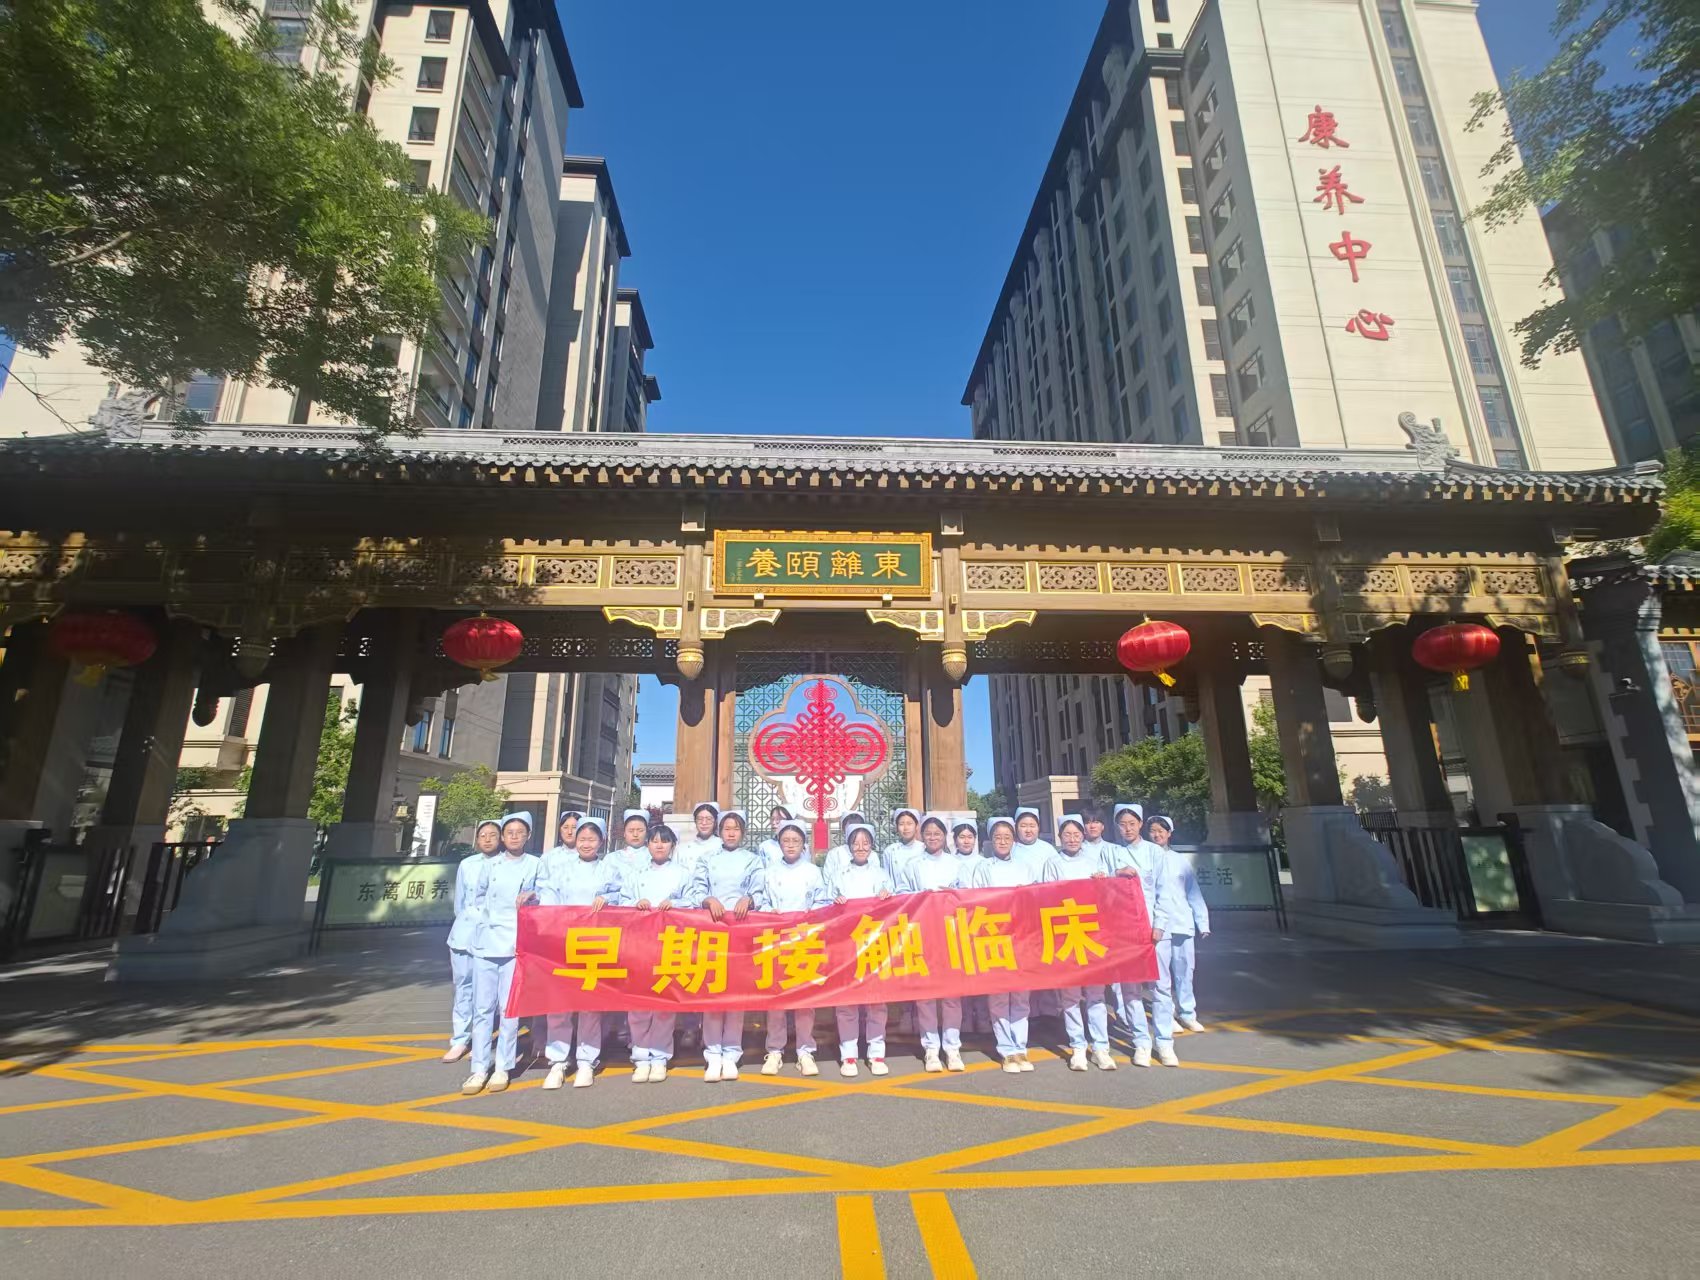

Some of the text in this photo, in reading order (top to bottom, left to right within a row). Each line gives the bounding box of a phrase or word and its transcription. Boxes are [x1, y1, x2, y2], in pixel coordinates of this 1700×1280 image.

[1298, 105, 1395, 341] 康养中心
[358, 880, 449, 901] 东篱颐养
[553, 898, 1108, 993] 早期接触临床
